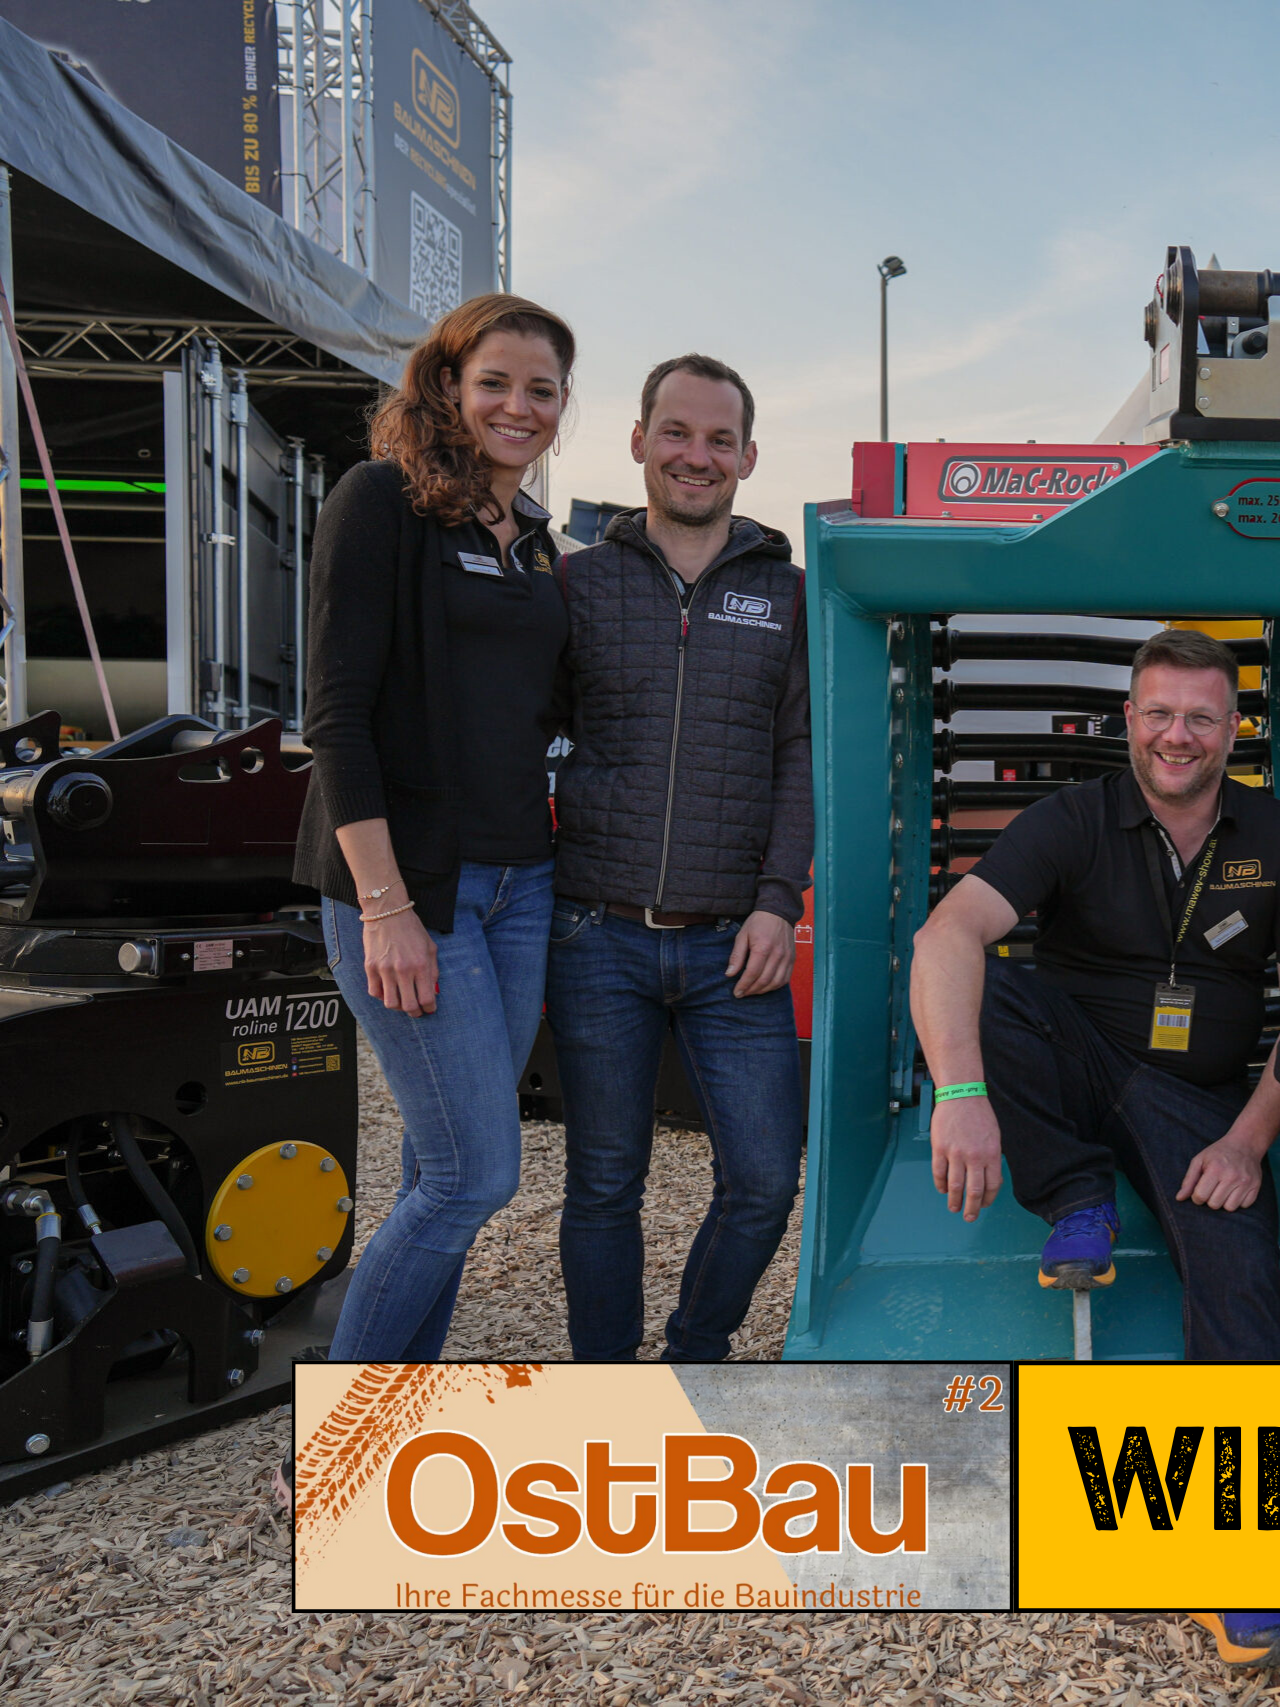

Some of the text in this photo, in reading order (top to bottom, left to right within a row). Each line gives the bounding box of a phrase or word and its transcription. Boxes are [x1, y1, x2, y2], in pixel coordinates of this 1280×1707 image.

[244, 46, 258, 91] DEINER
[242, 95, 257, 108] %
[243, 113, 258, 133] 80
[244, 138, 259, 161] ZU
[393, 100, 476, 191] BAUMASCHINEN
[245, 165, 260, 193] BIS
[1238, 496, 1263, 506] max.
[1238, 514, 1267, 524] max.
[707, 612, 782, 631] BAUMASCHINEN
[1209, 881, 1277, 890] BAUMASCHINEN
[225, 995, 339, 1032] UAM 1200
[224, 1063, 288, 1077] BAUMASCHINEN
